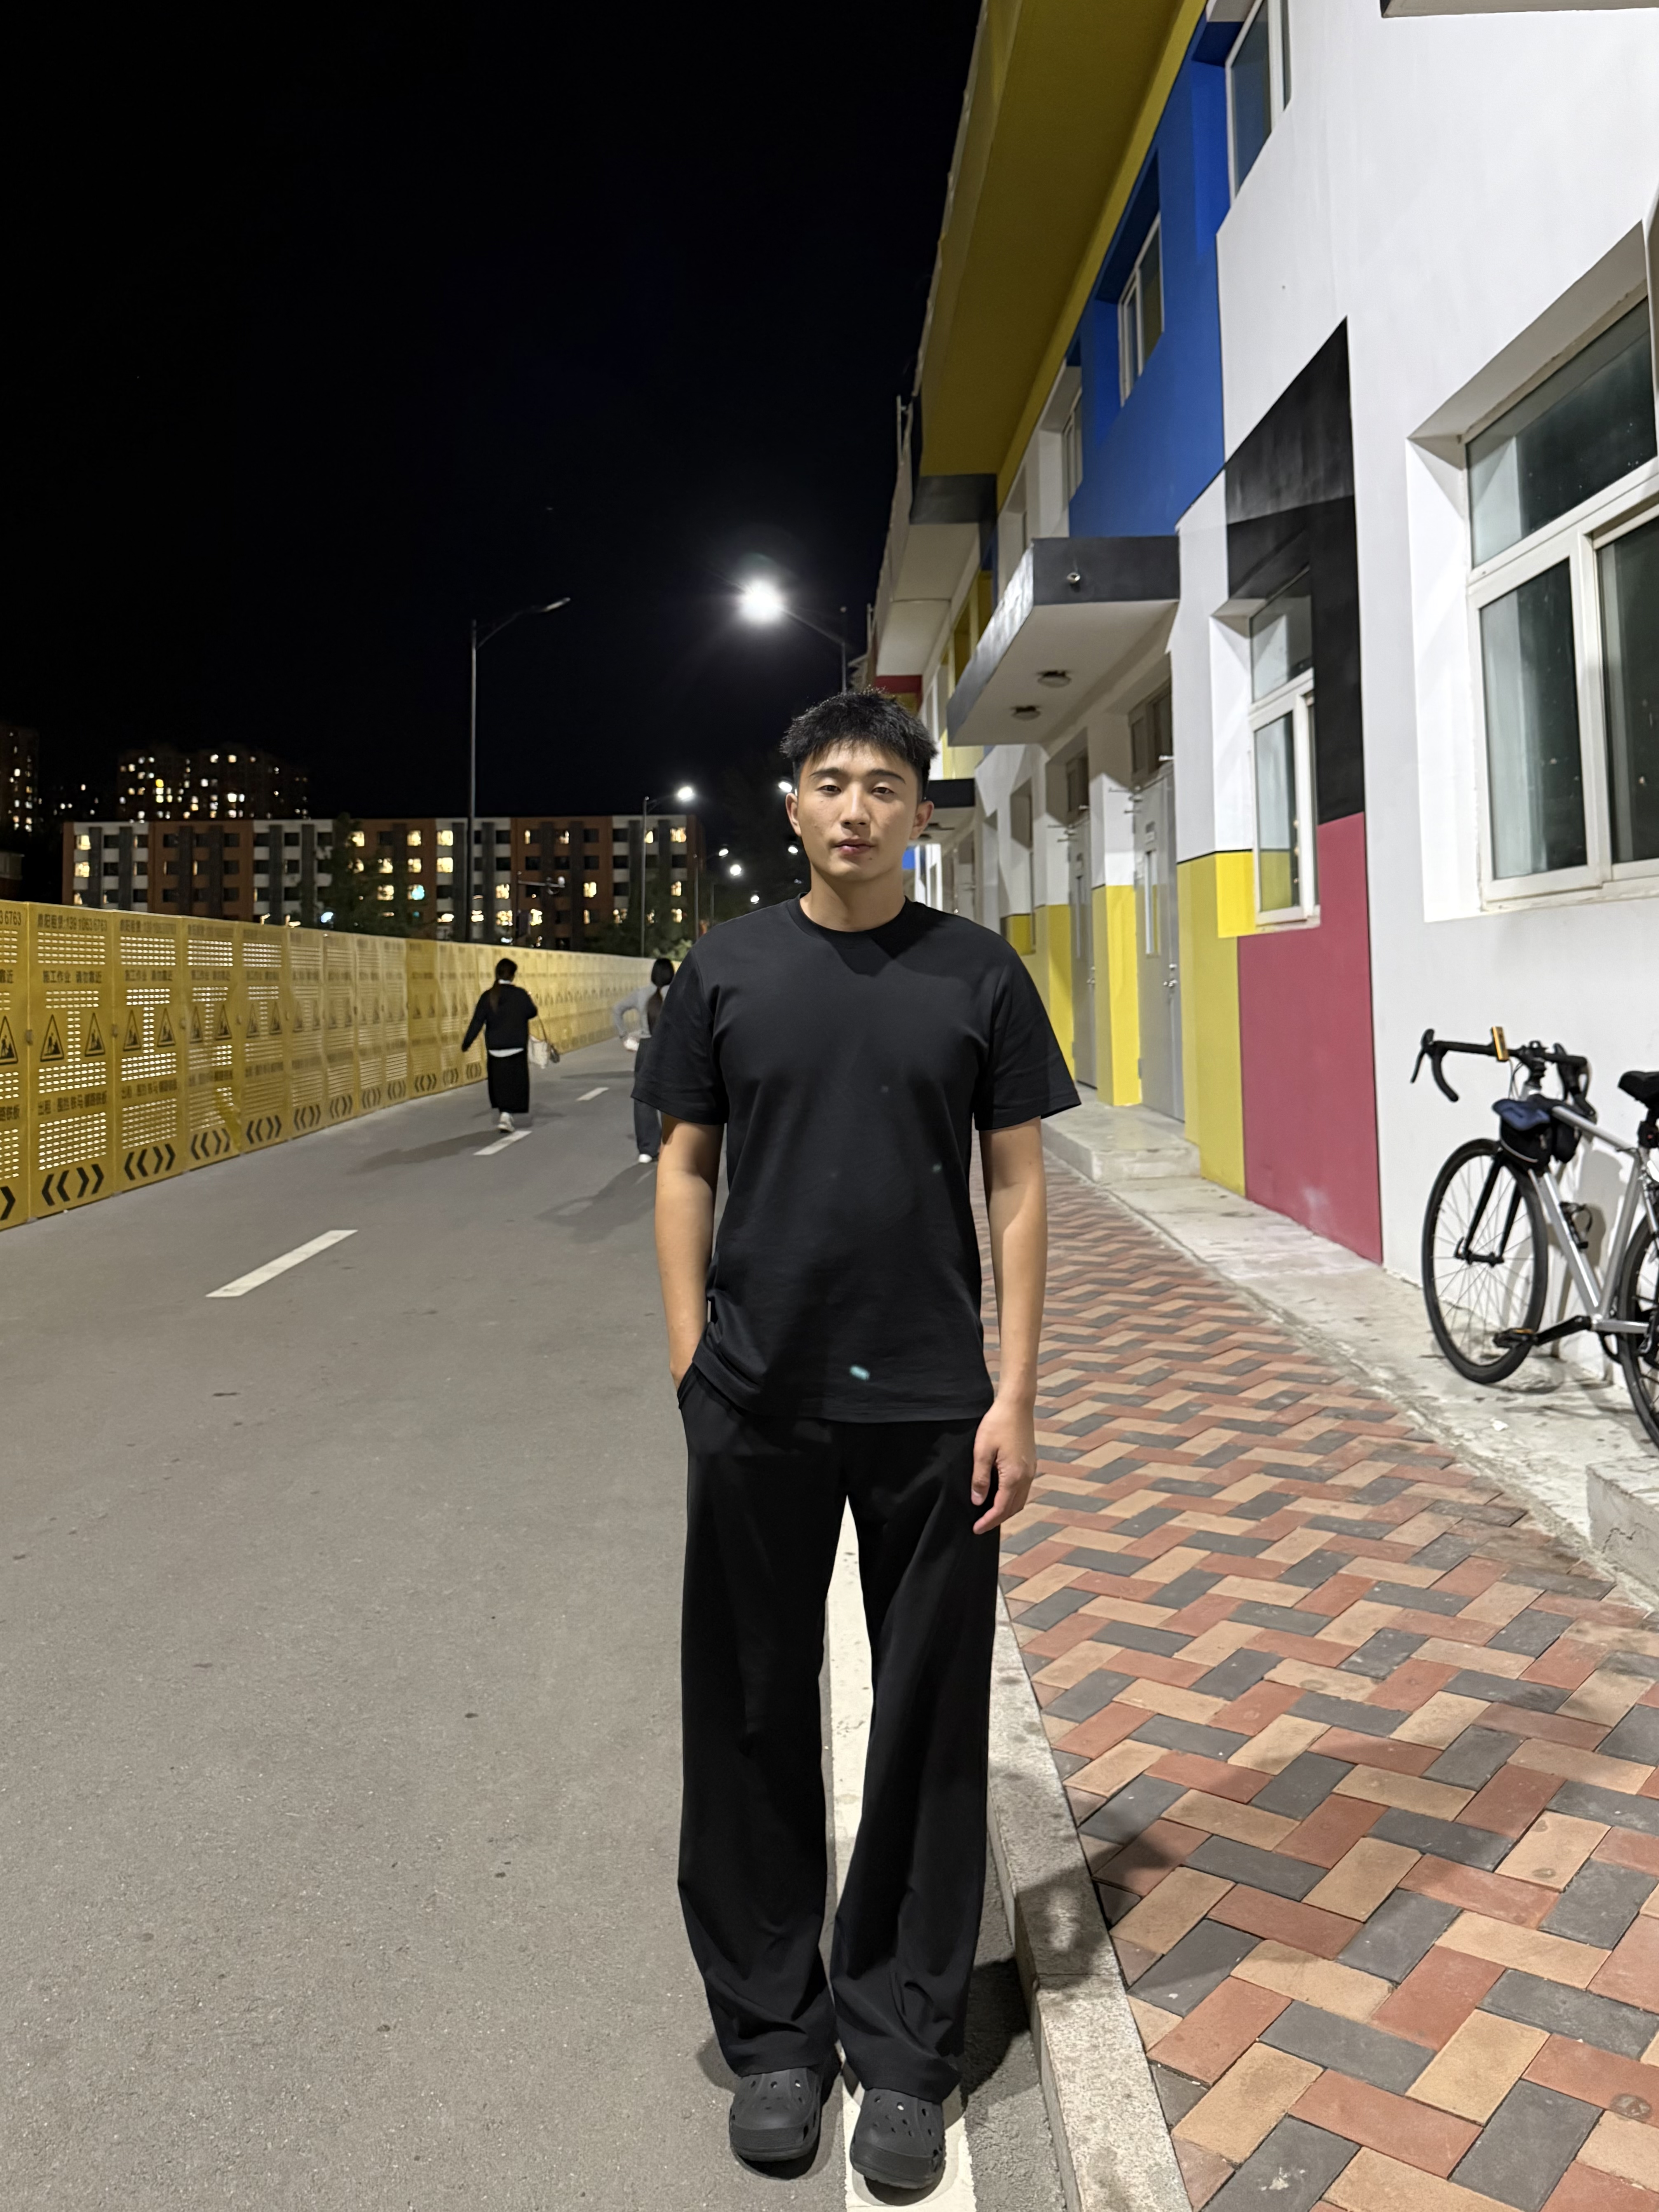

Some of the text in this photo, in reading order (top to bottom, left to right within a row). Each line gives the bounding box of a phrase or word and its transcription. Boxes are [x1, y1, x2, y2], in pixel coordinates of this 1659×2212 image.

[4, 911, 21, 926] 6763
[43, 970, 102, 984] 施工作业 请勿靠近
